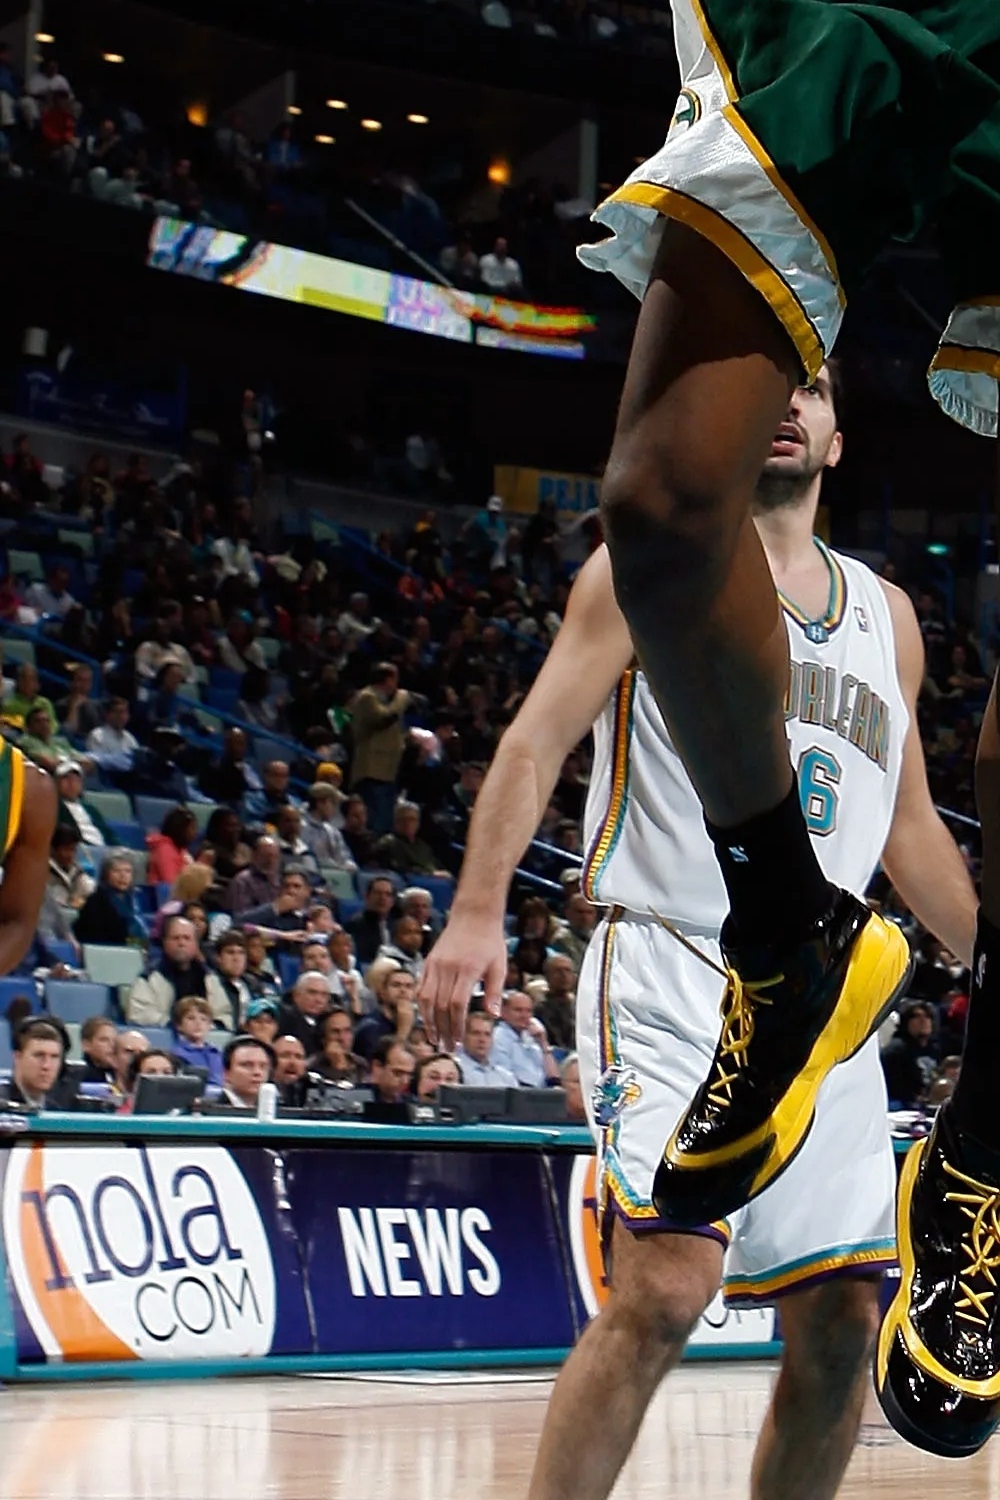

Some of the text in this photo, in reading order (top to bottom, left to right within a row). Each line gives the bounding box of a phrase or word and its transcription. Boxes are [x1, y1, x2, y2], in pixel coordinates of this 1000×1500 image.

[788, 744, 842, 837] 6
[21, 1142, 243, 1292] nola
[337, 1206, 501, 1297] NEWS
[134, 1267, 263, 1347] .COM
